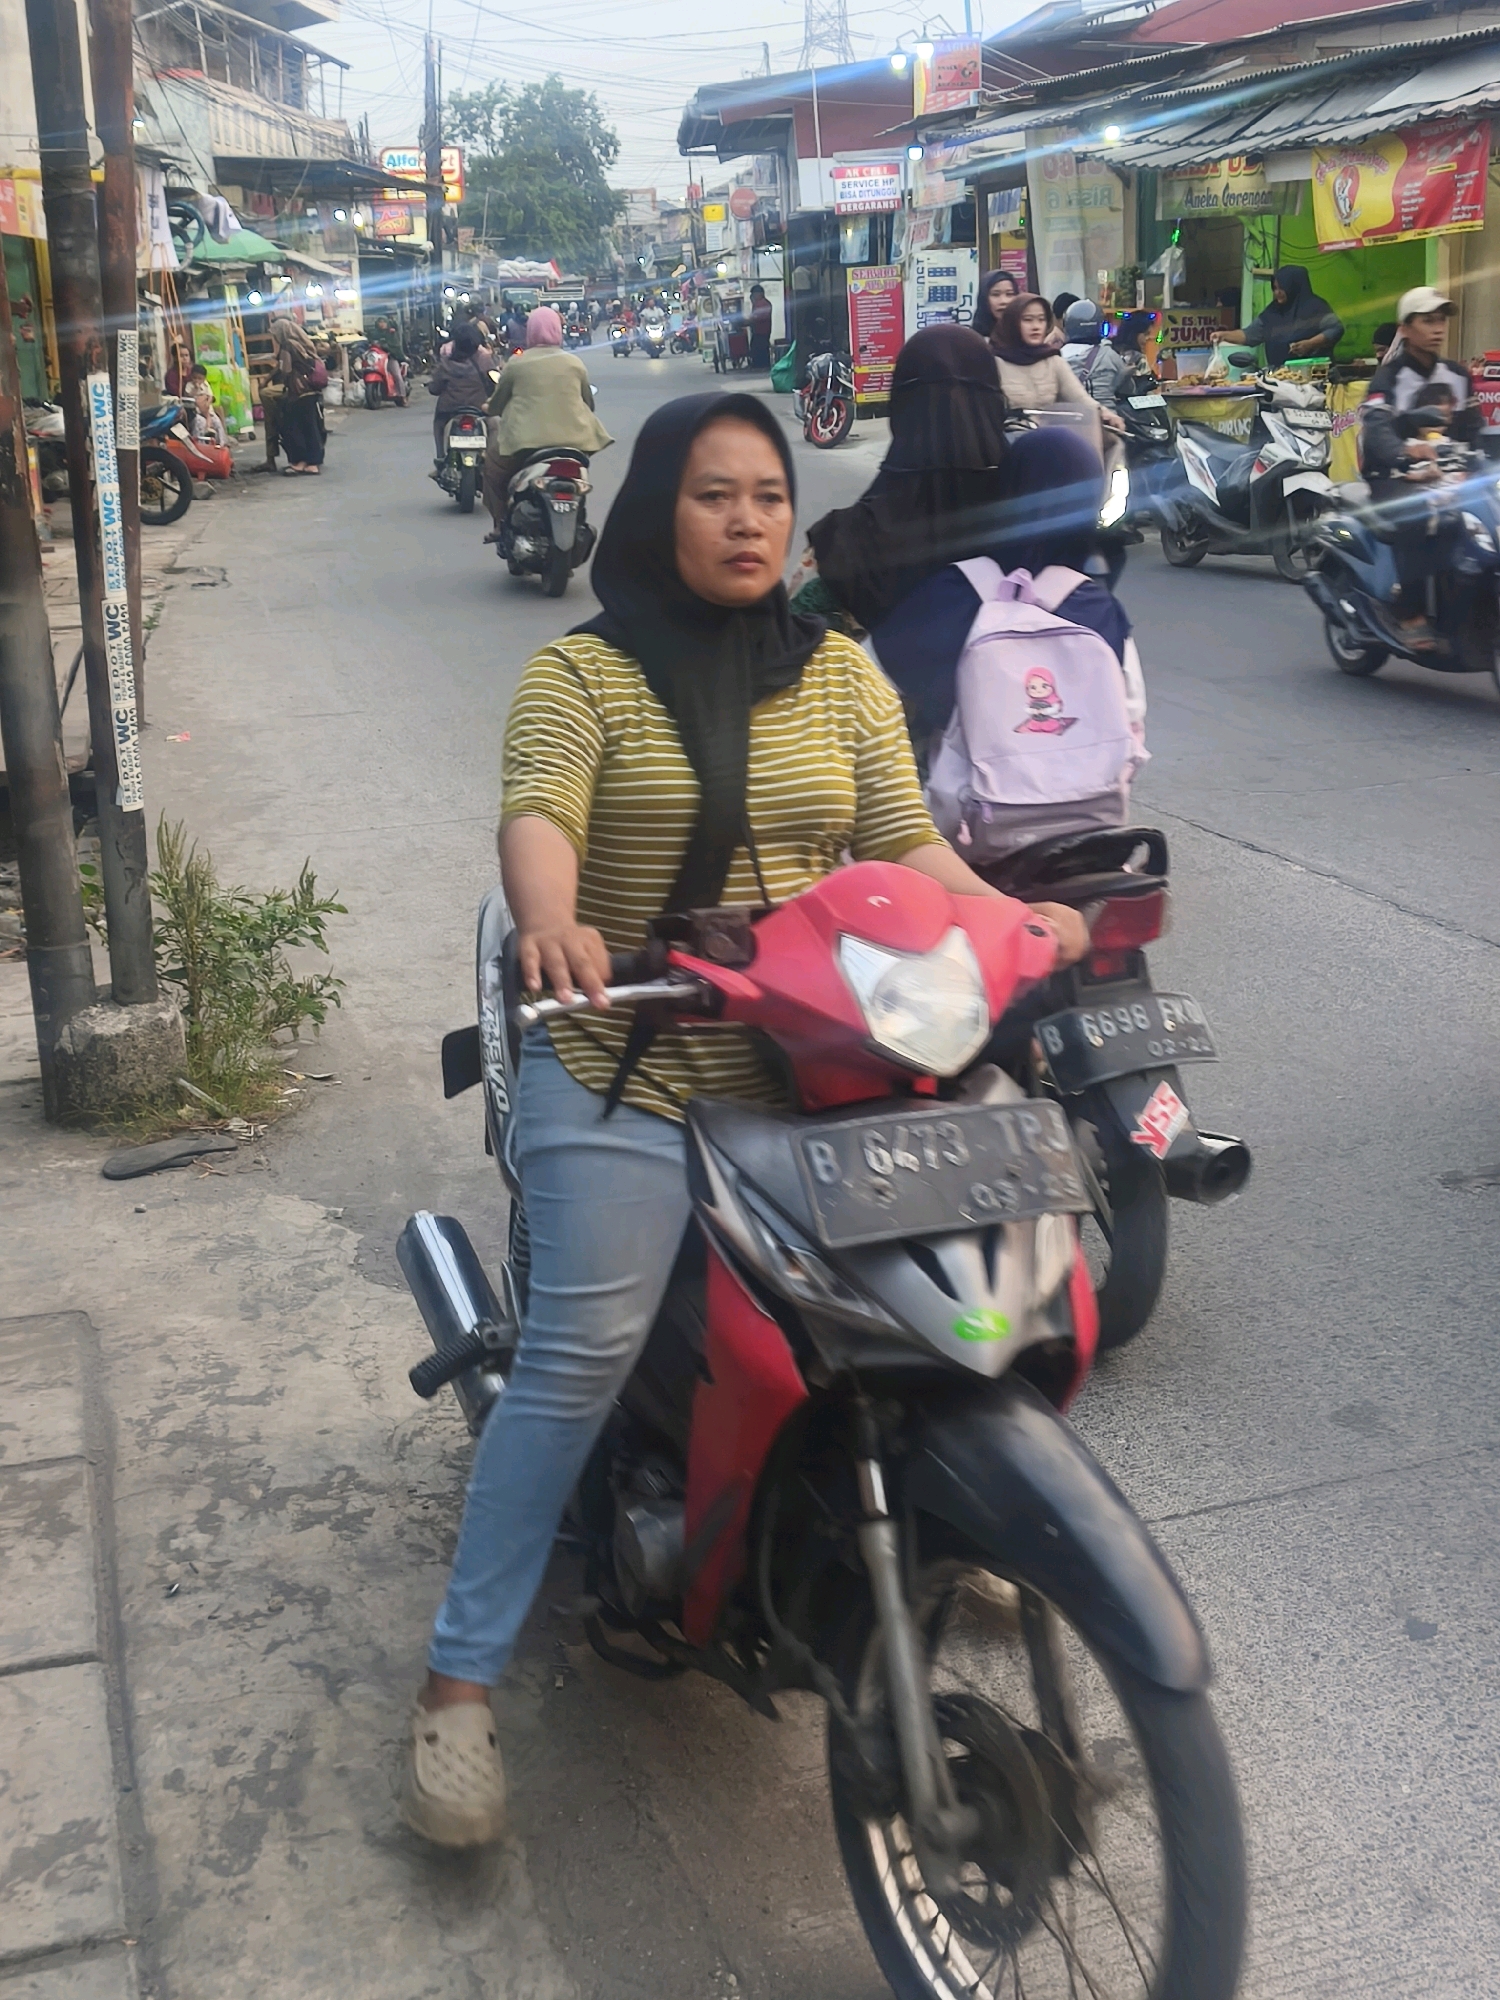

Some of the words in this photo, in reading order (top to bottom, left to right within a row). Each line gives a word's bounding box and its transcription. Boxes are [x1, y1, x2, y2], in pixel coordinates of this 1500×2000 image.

[840, 190, 857, 199] BISA
[858, 187, 897, 198] DITUNGGU
[841, 179, 880, 189] SERVICE
[882, 178, 895, 187] HP
[1185, 187, 1218, 208] Aneka
[840, 200, 898, 212] BERGARANSI
[1182, 316, 1194, 326] ES
[1196, 316, 1217, 326] TEH
[92, 381, 107, 420] WC
[96, 421, 108, 485] SEDOT
[102, 490, 117, 527] WC
[106, 529, 118, 591] SEDOT
[105, 603, 121, 641] WC
[109, 643, 122, 702] SEDOT
[115, 707, 131, 745] WC
[119, 749, 132, 804] SEDOT
[1041, 1023, 1065, 1055] B
[1080, 1003, 1151, 1046] 6698
[805, 1138, 843, 1186] B
[862, 1120, 972, 1176] 6473
